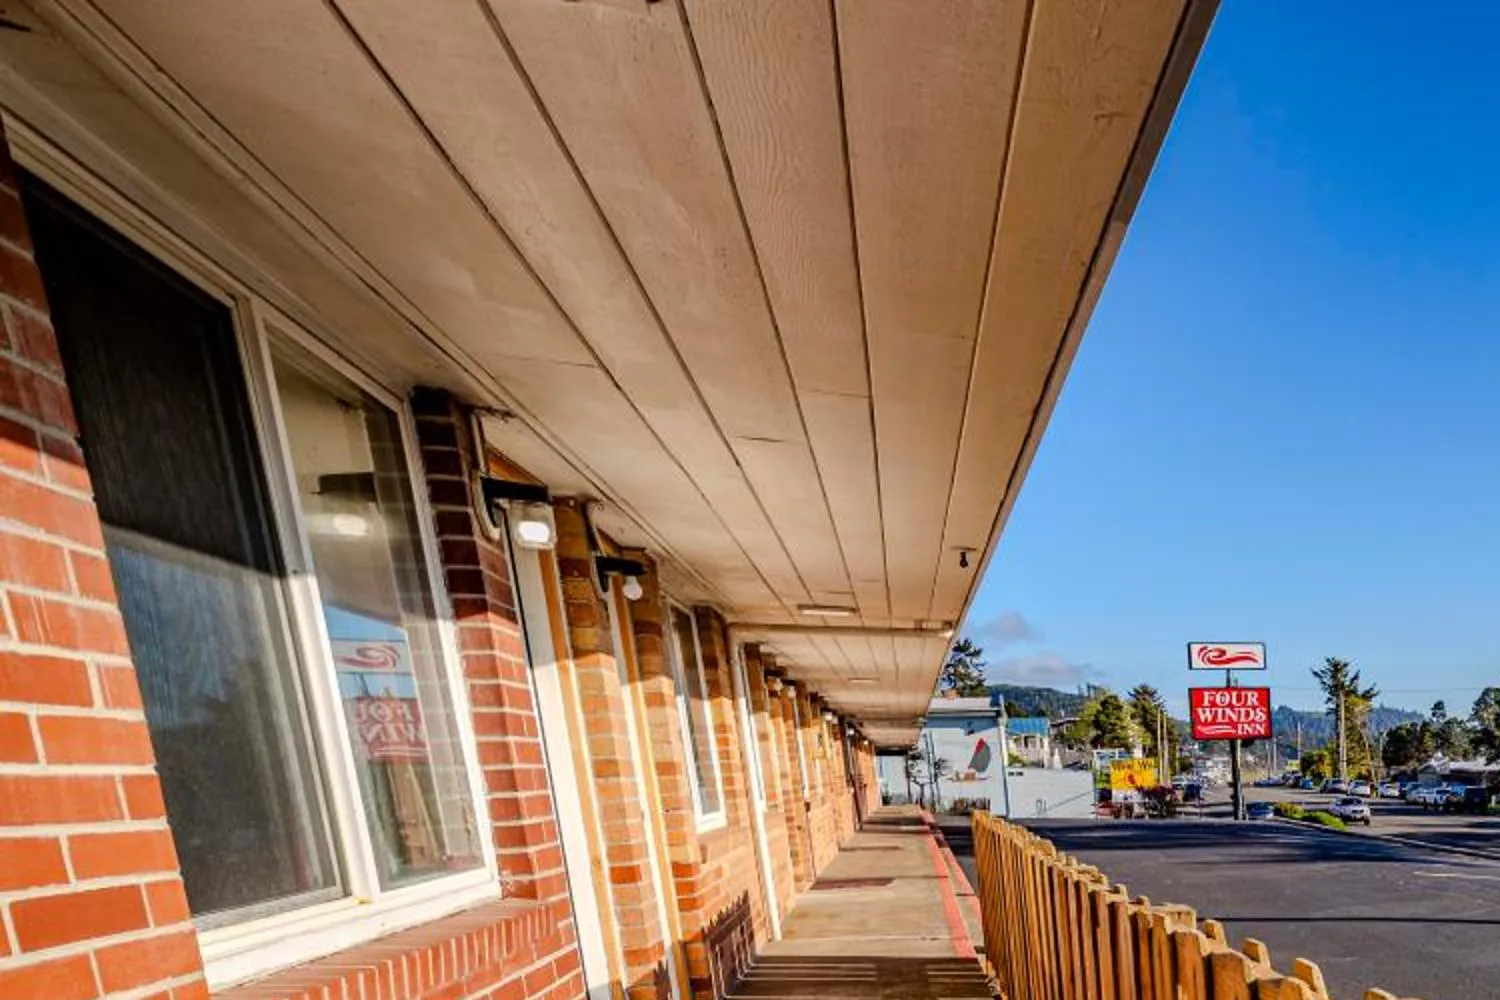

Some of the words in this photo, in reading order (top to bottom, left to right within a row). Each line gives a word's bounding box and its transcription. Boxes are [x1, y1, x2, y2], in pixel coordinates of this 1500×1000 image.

[1203, 691, 1260, 706] FOUR
[1196, 708, 1267, 722] WINDS
[1237, 724, 1265, 735] INN
